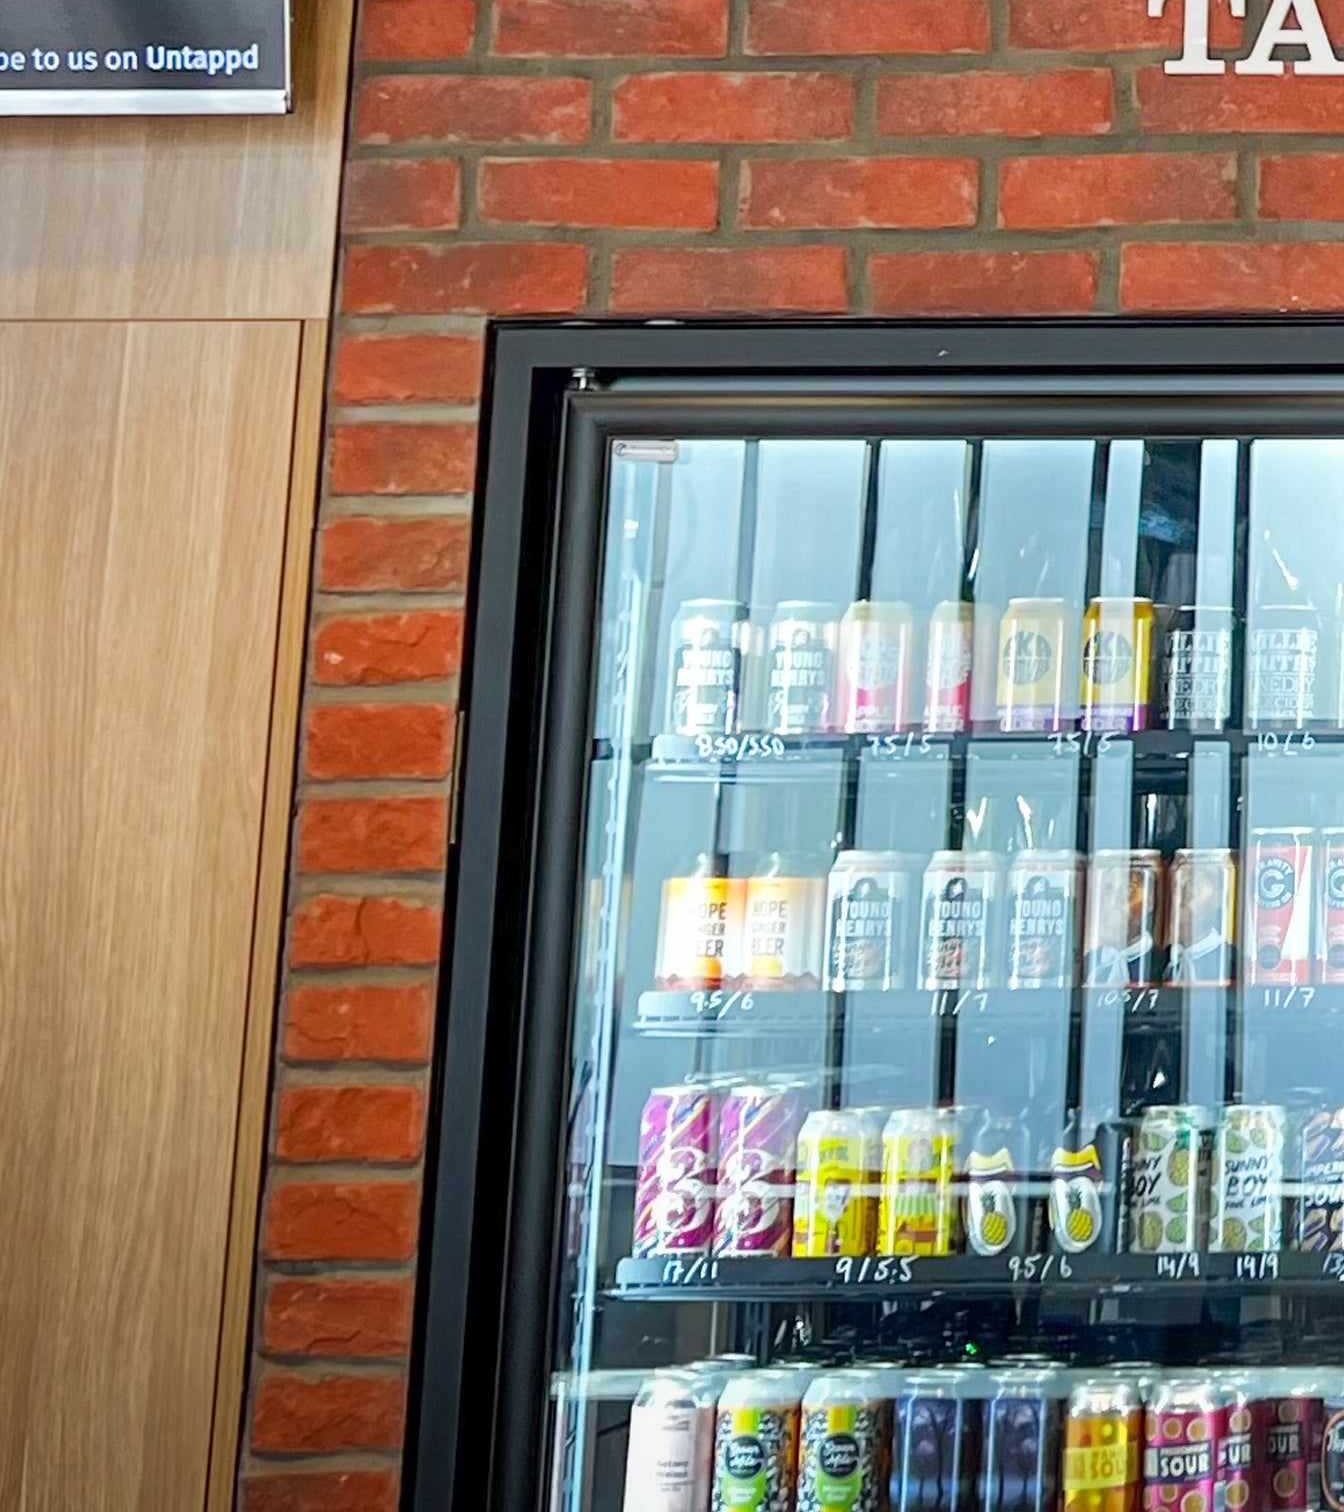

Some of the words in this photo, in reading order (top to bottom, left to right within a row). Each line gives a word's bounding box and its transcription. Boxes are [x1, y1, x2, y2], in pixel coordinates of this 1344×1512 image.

[31, 47, 60, 71] to
[67, 51, 98, 71] us
[104, 51, 138, 71] on
[146, 43, 259, 76] Untappd
[1225, 1172, 1273, 1197] BOY
[1159, 1452, 1211, 1478] SOUR
